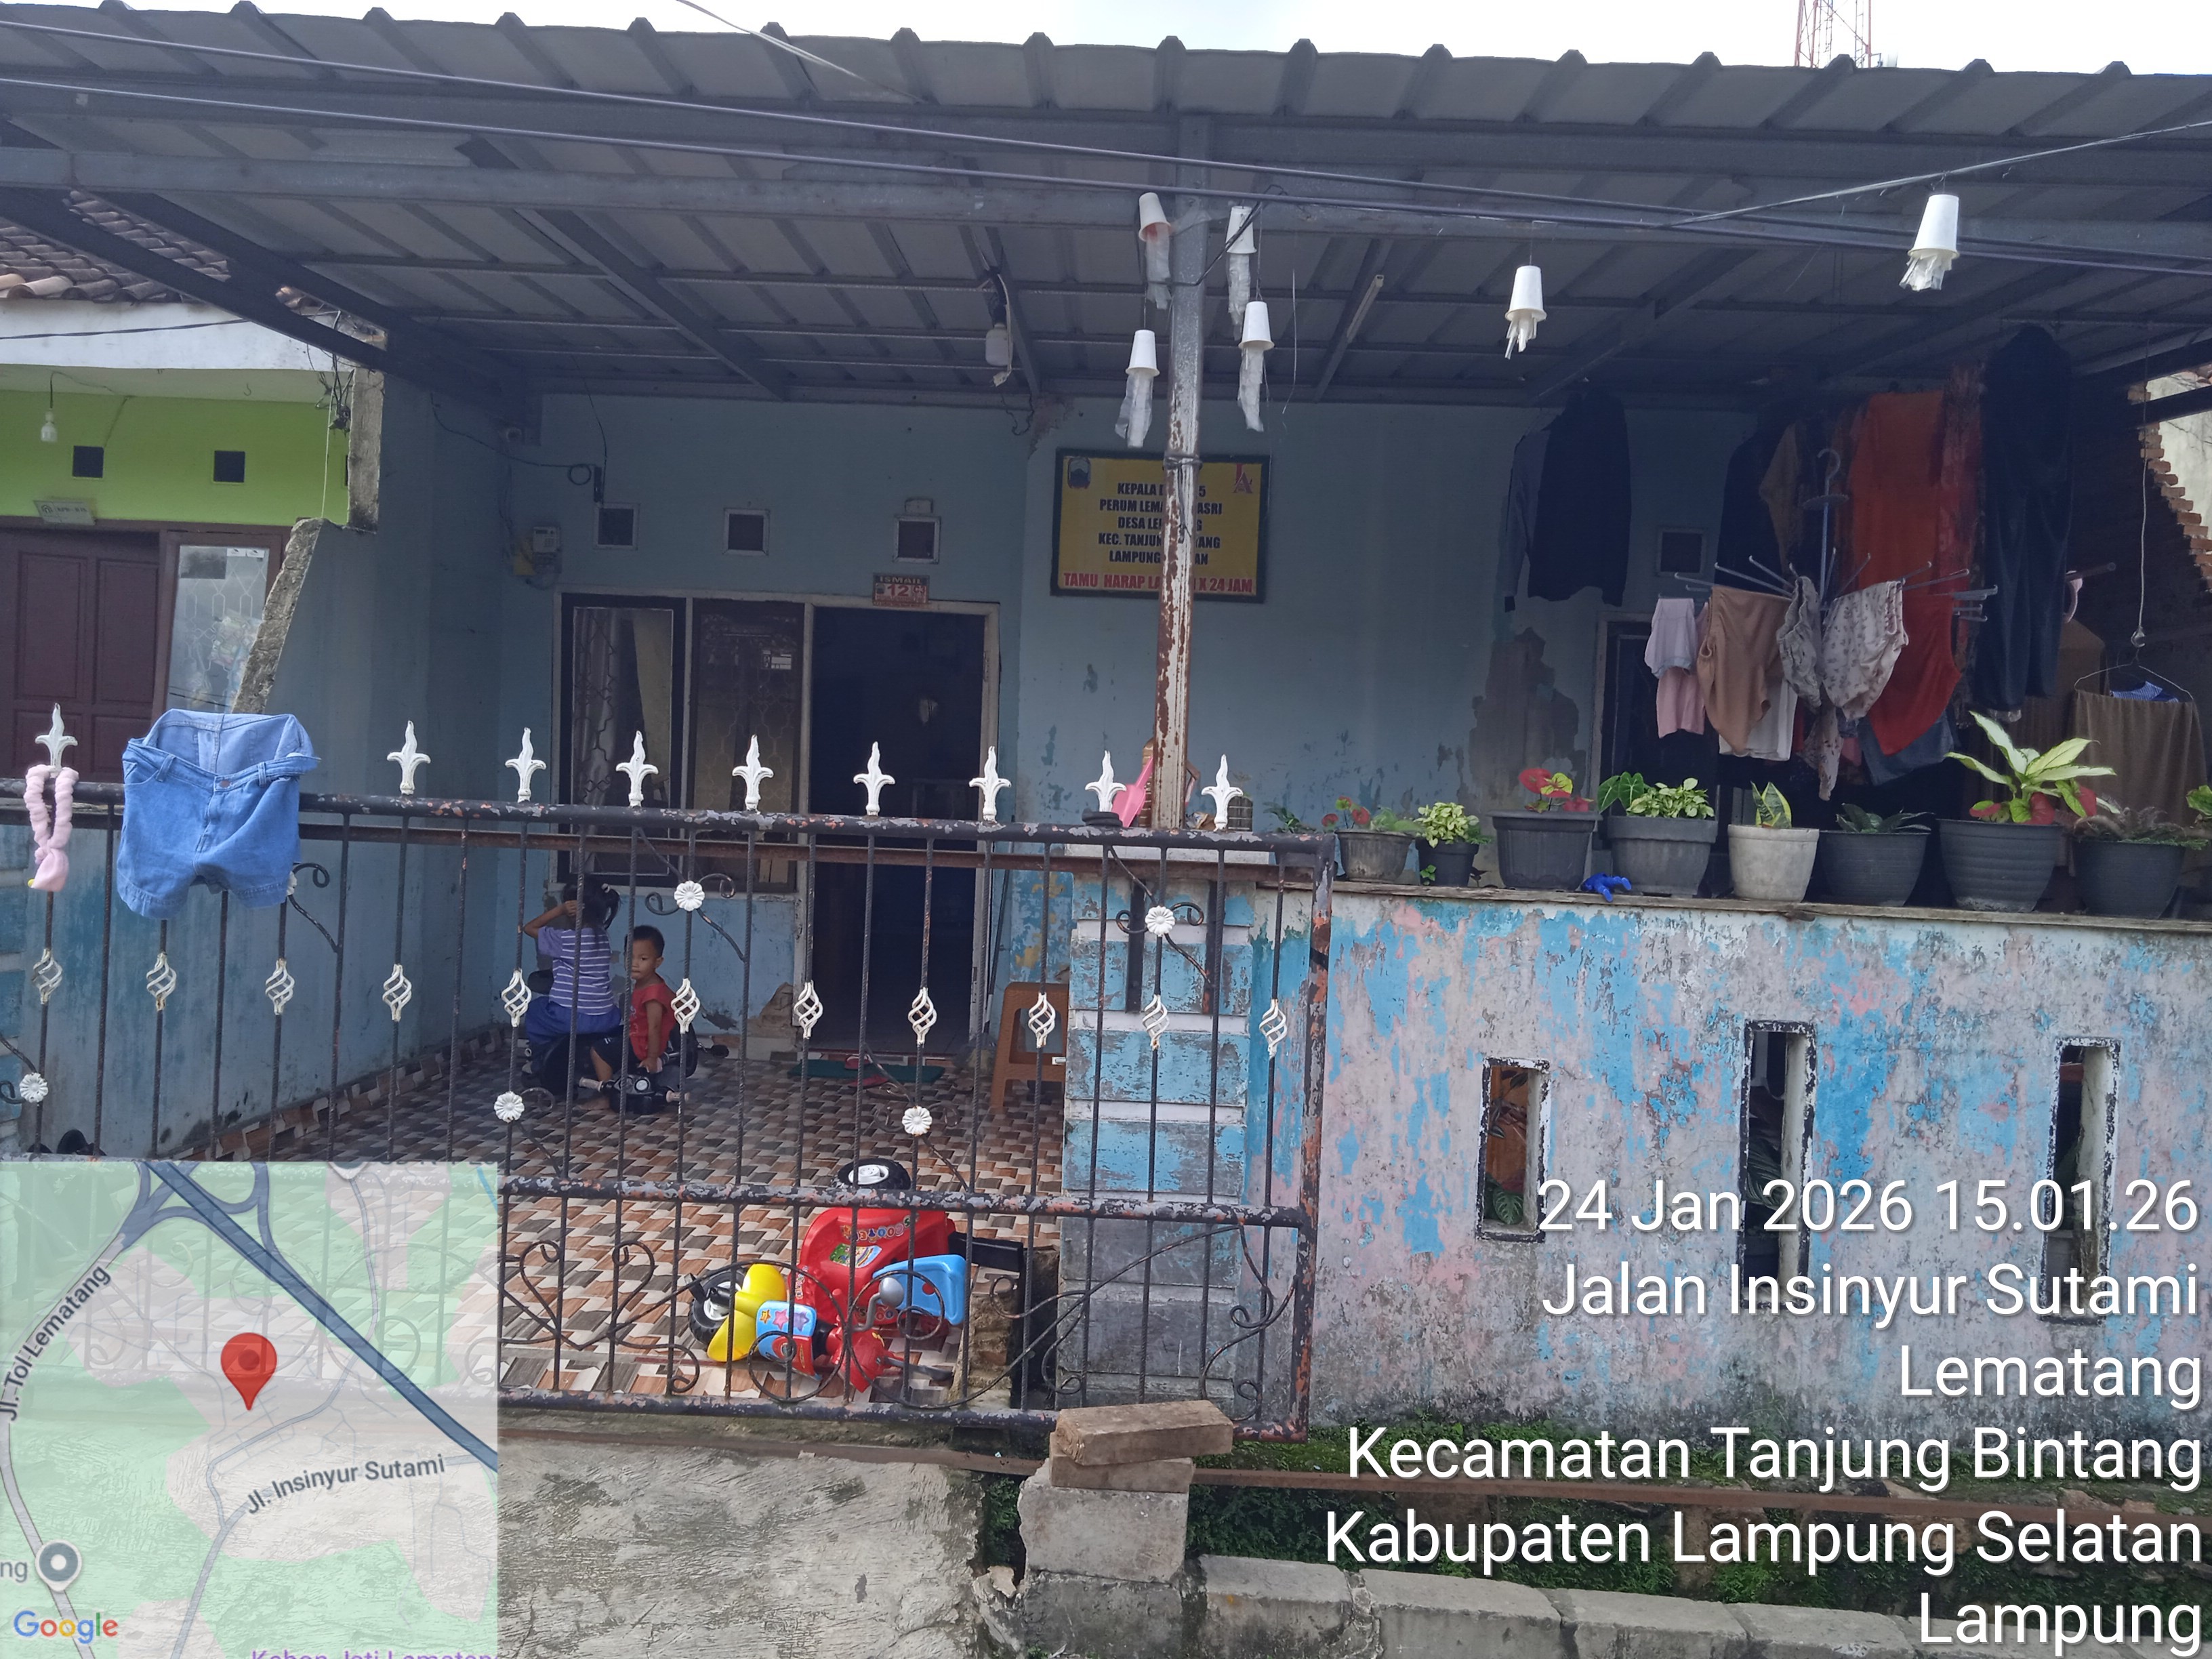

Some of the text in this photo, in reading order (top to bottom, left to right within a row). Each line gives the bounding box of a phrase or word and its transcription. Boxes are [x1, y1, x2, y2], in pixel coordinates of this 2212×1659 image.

[1117, 483, 1156, 495] KEPALA
[1198, 485, 1206, 497] 5
[1099, 499, 1137, 512] PERUM
[1197, 502, 1223, 515] ASRI
[1118, 516, 1145, 529] DESA
[1099, 533, 1162, 547] KEC. TANJUN
[1109, 550, 1161, 564] LAMPUNG
[880, 576, 921, 584] ISMAIL
[1063, 573, 1098, 588] TAMU
[1104, 574, 1145, 589] HARAP
[1199, 577, 1206, 592] X
[1209, 577, 1225, 592] 24
[1227, 578, 1253, 593] JAM
[887, 583, 909, 597] 12
